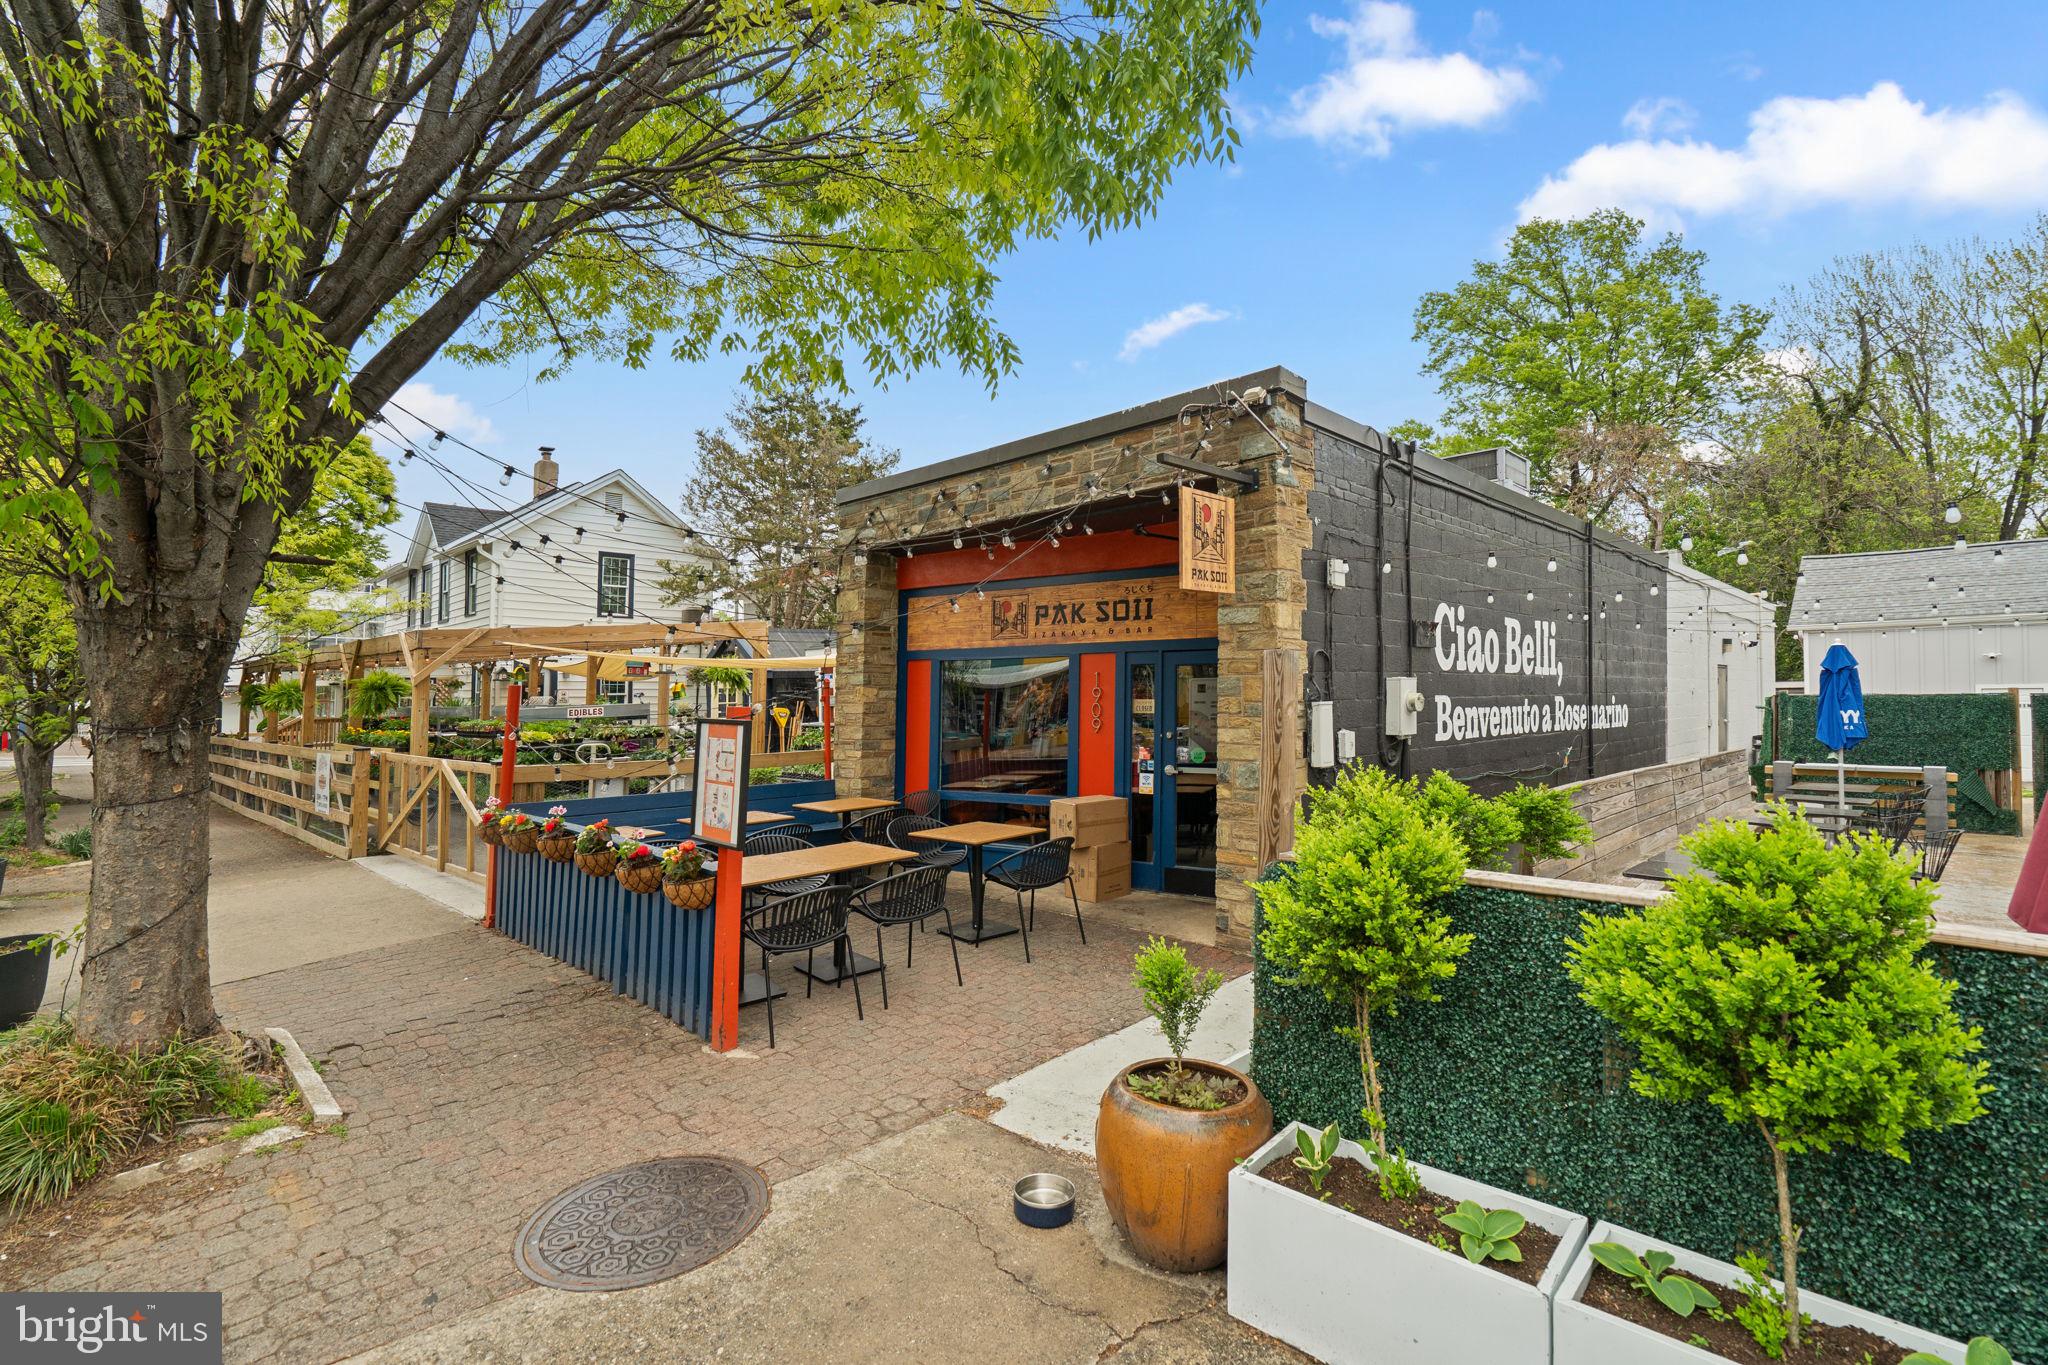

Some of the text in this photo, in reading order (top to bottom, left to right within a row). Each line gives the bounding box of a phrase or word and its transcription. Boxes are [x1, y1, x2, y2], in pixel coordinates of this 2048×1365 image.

[1191, 568, 1228, 583] PAK SOII
[1035, 597, 1154, 626] PAK SOII
[1034, 626, 1153, 638] IZAKAYA & BAR
[1434, 602, 1564, 687] Ciao Belli,
[569, 708, 602, 716] EDIBLES
[1091, 671, 1102, 734] 1909
[1434, 694, 1540, 742] Benvenuto
[1541, 703, 1552, 733] a
